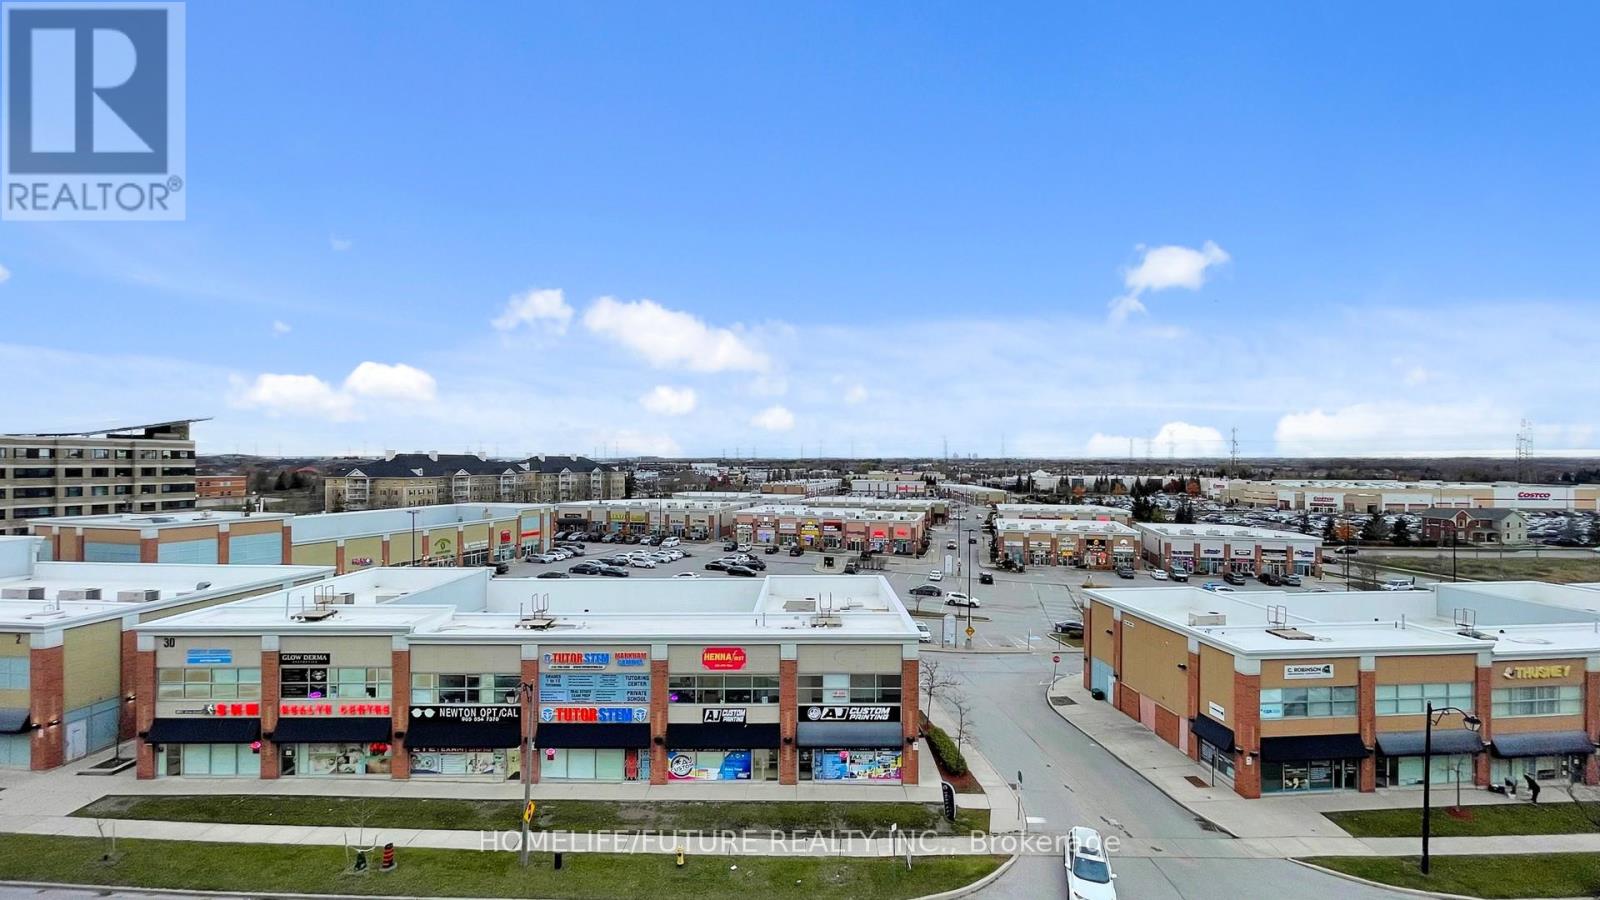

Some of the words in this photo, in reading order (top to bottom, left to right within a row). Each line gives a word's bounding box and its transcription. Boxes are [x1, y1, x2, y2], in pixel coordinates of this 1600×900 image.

[16, 634, 21, 644] 2
[163, 637, 176, 648] 30
[552, 652, 583, 665] TUTOR
[584, 652, 610, 665] STEM
[704, 652, 732, 661] HENNA
[439, 708, 477, 717] NEWTON
[555, 708, 597, 721] TUTOR
[598, 708, 633, 721] STEM
[849, 707, 890, 715] CUSTOM
